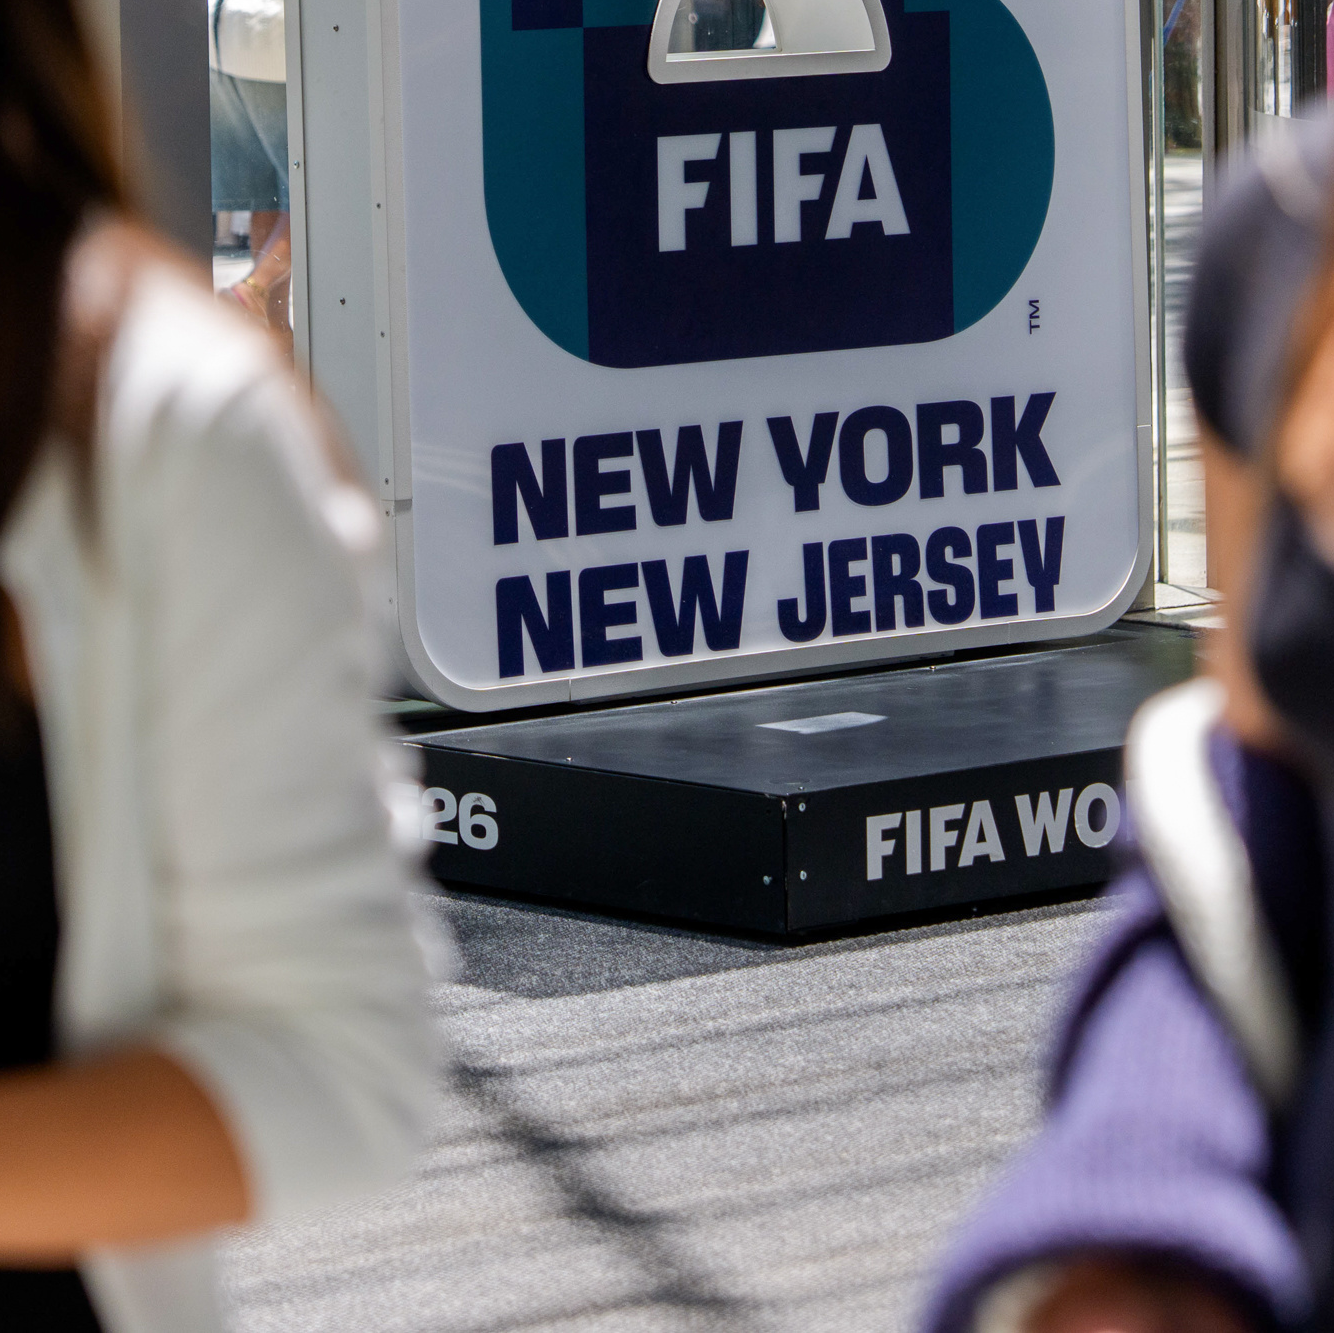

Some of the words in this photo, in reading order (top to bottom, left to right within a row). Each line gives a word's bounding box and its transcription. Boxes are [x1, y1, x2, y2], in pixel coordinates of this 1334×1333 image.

[657, 123, 911, 252] FIFA
[1029, 299, 1040, 334] TM
[491, 420, 743, 546] NEW
[766, 391, 1062, 513] YORK
[495, 550, 750, 679] NEW
[777, 516, 1065, 643] JERSEY
[866, 799, 1006, 881] FIFA
[1015, 781, 1129, 857] WO
